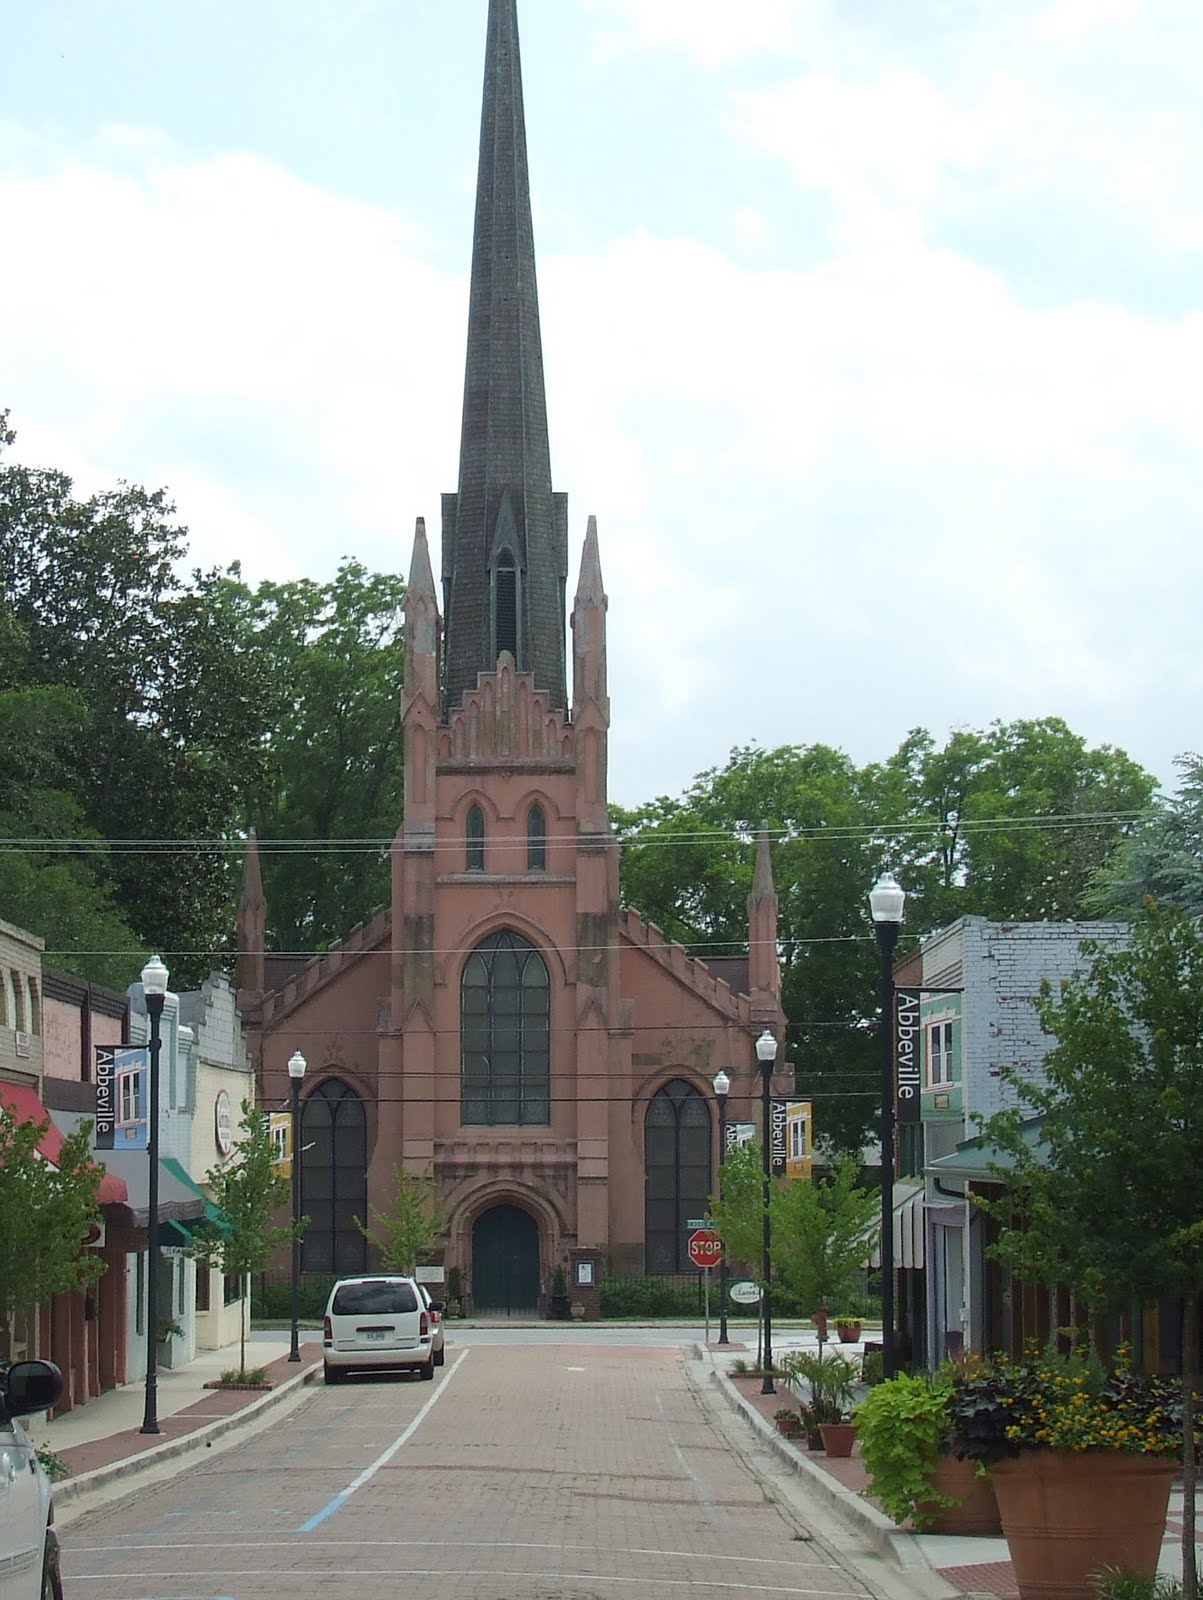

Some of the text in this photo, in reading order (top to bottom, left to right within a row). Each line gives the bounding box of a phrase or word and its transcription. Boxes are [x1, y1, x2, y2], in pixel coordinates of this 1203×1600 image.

[897, 992, 920, 1099] Abbeville
[96, 1049, 114, 1133] Abbeville
[772, 1102, 787, 1166] Abbeville
[691, 1241, 722, 1255] STOP
